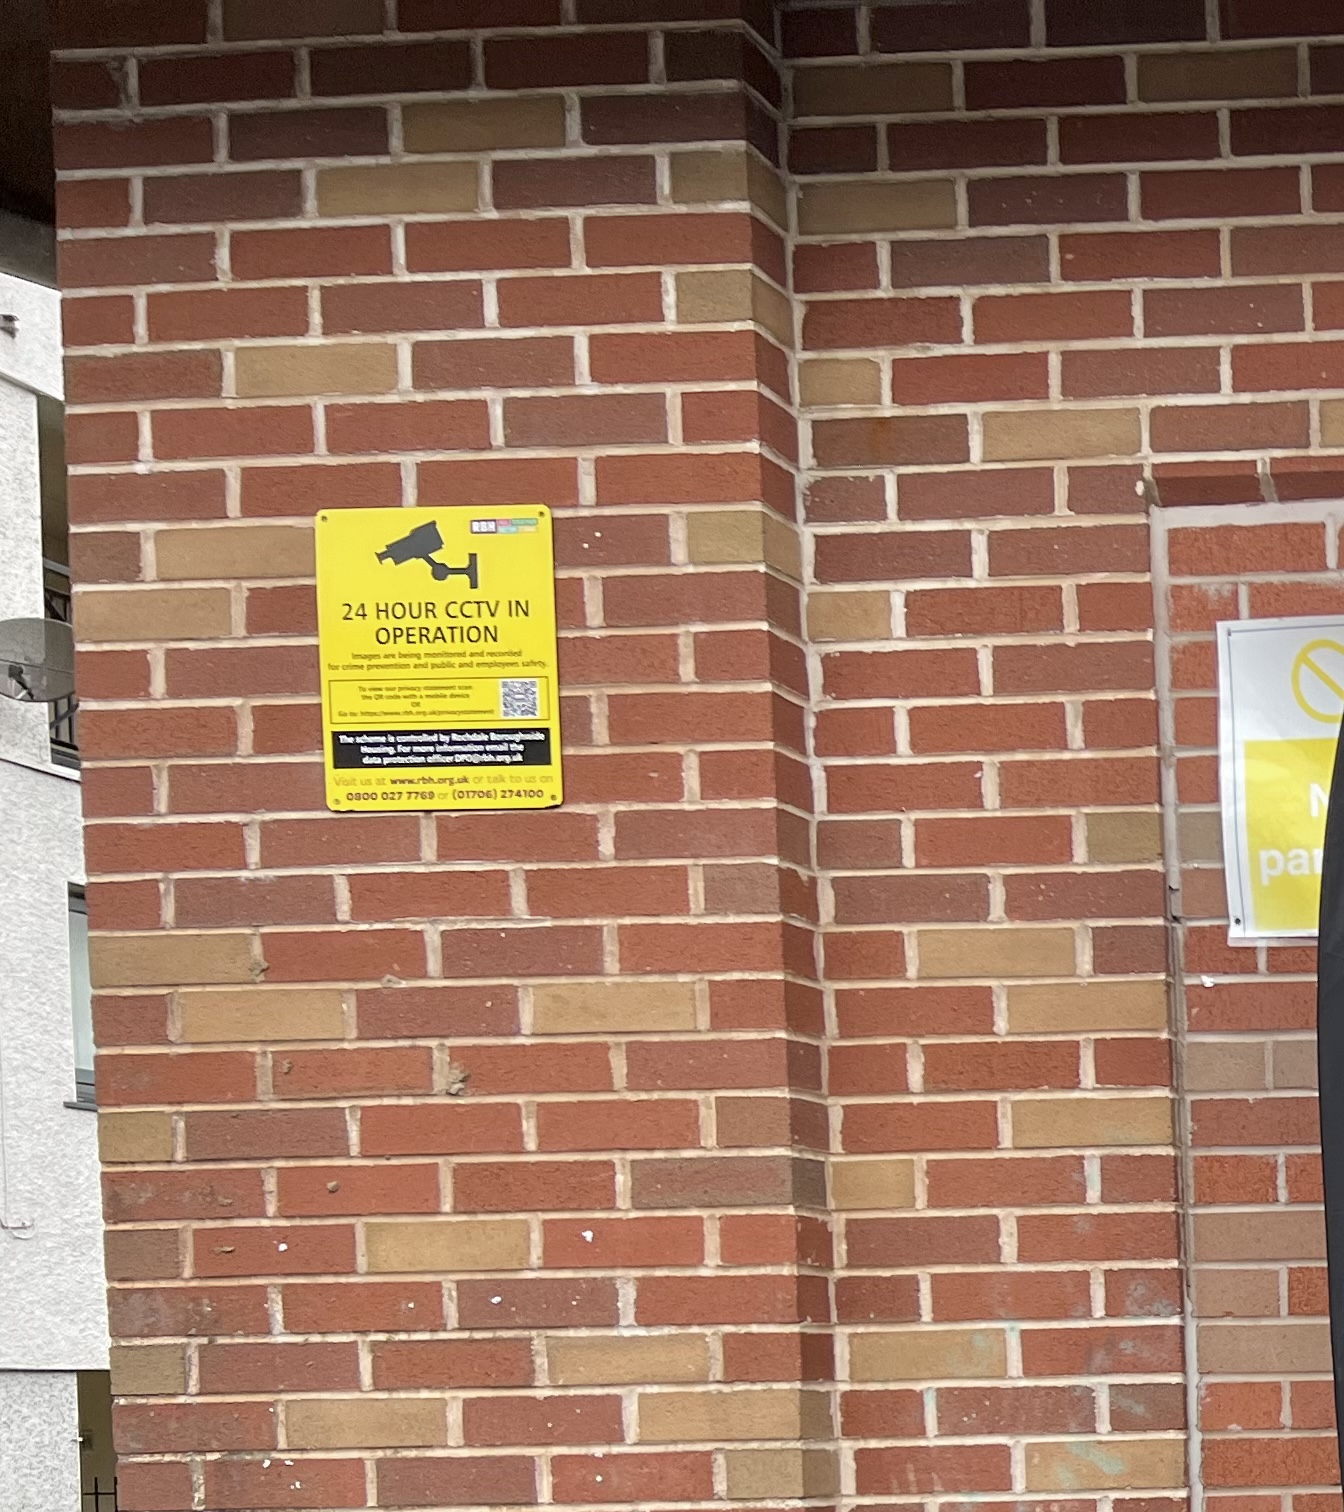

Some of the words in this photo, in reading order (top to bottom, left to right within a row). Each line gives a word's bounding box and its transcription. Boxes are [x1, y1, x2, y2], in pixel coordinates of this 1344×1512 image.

[341, 603, 368, 620] 24
[375, 602, 438, 620] HOUR
[445, 600, 500, 618] CCTV
[508, 600, 530, 617] IN
[375, 625, 499, 645] OPERATION
[398, 651, 421, 660] being
[366, 663, 411, 671] prevention
[413, 661, 428, 669] and
[430, 661, 455, 670] public
[458, 660, 473, 668] and
[339, 735, 354, 743] The
[439, 733, 450, 743] by
[510, 743, 524, 751] the
[334, 777, 356, 787] Visit
[359, 778, 373, 786] us
[376, 777, 386, 786] at
[390, 775, 469, 787] www.rbh.org.uk
[472, 776, 484, 784] or
[486, 775, 505, 784] talk
[509, 775, 522, 784] to
[525, 776, 537, 784] us
[540, 775, 554, 783] on
[346, 791, 378, 801] 0800
[380, 791, 404, 801] 027
[406, 791, 435, 800] 7769
[438, 792, 450, 800] or
[451, 788, 497, 801] (01706)
[500, 789, 544, 799] 274100
